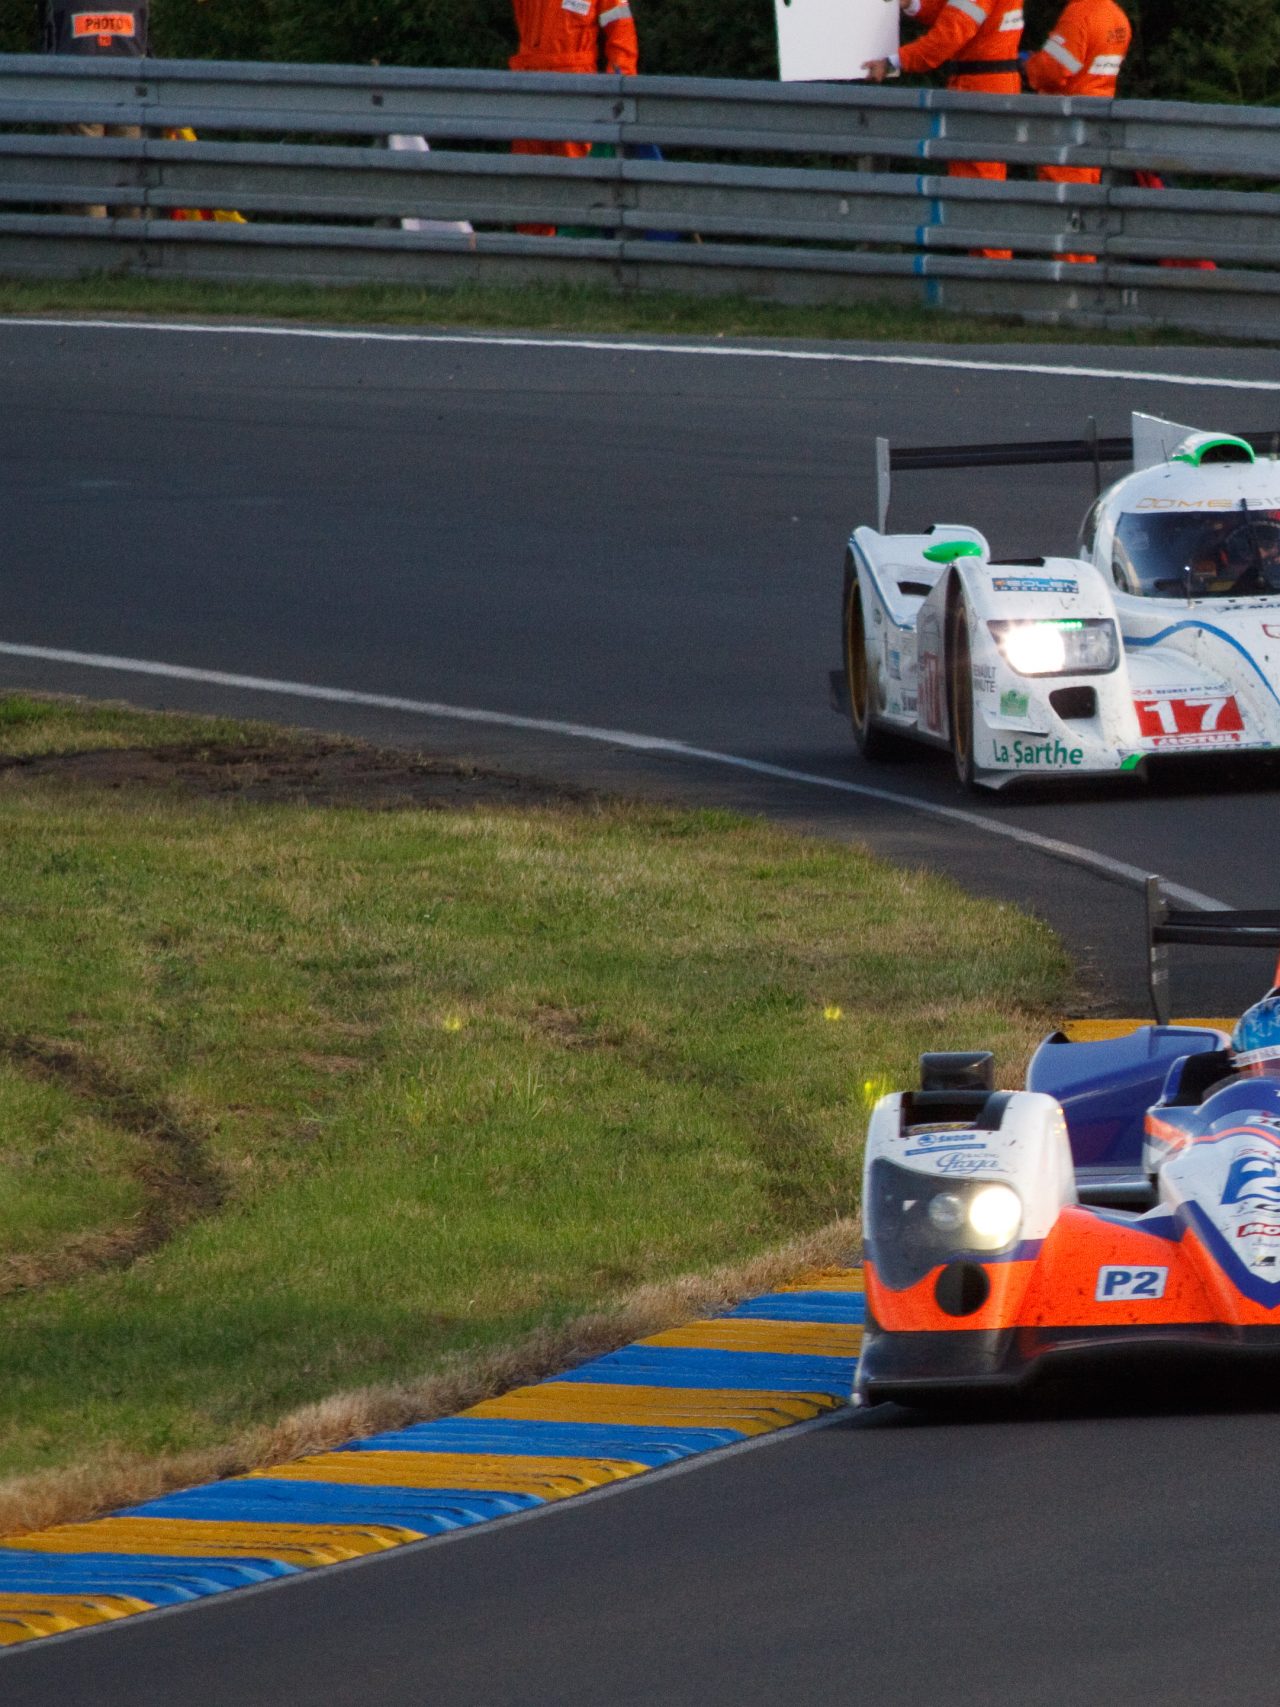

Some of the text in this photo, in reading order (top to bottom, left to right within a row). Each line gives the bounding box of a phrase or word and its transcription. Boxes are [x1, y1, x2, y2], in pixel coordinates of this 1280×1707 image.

[85, 18, 123, 31] PHOTO
[1143, 699, 1228, 735] 17
[992, 739, 1083, 766] La Sarthe
[1103, 1270, 1159, 1296] P2
